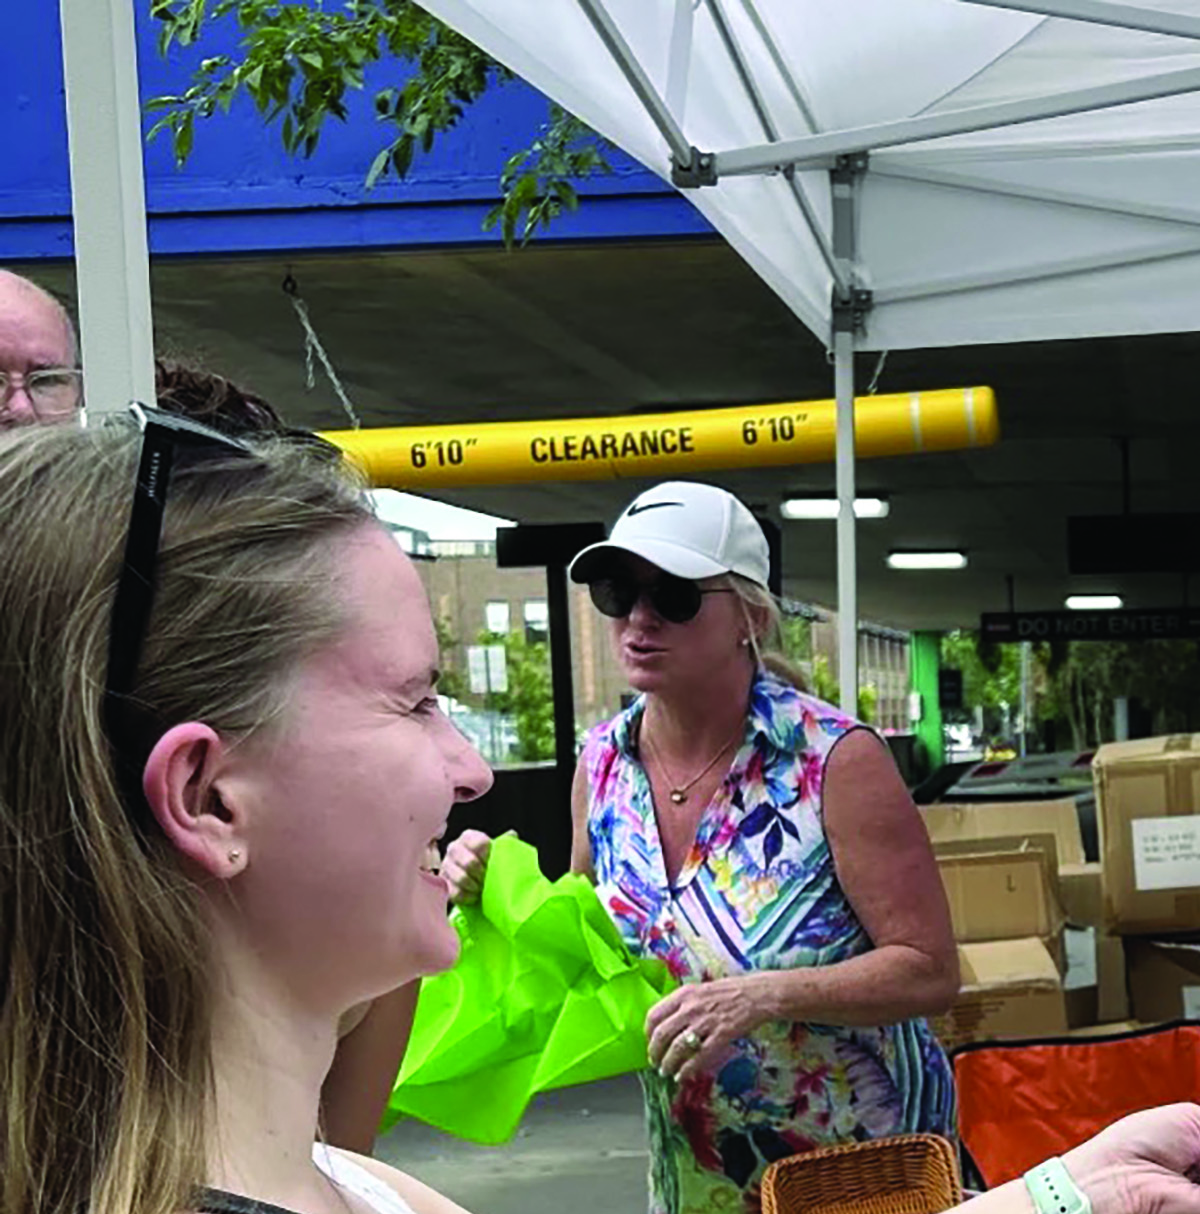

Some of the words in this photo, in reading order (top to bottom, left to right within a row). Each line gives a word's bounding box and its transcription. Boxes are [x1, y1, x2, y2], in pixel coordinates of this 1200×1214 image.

[530, 427, 695, 463] CLEARANCE
[1018, 618, 1048, 636] DO
[1055, 616, 1101, 635] NOT
[1108, 614, 1179, 634] ENTER
